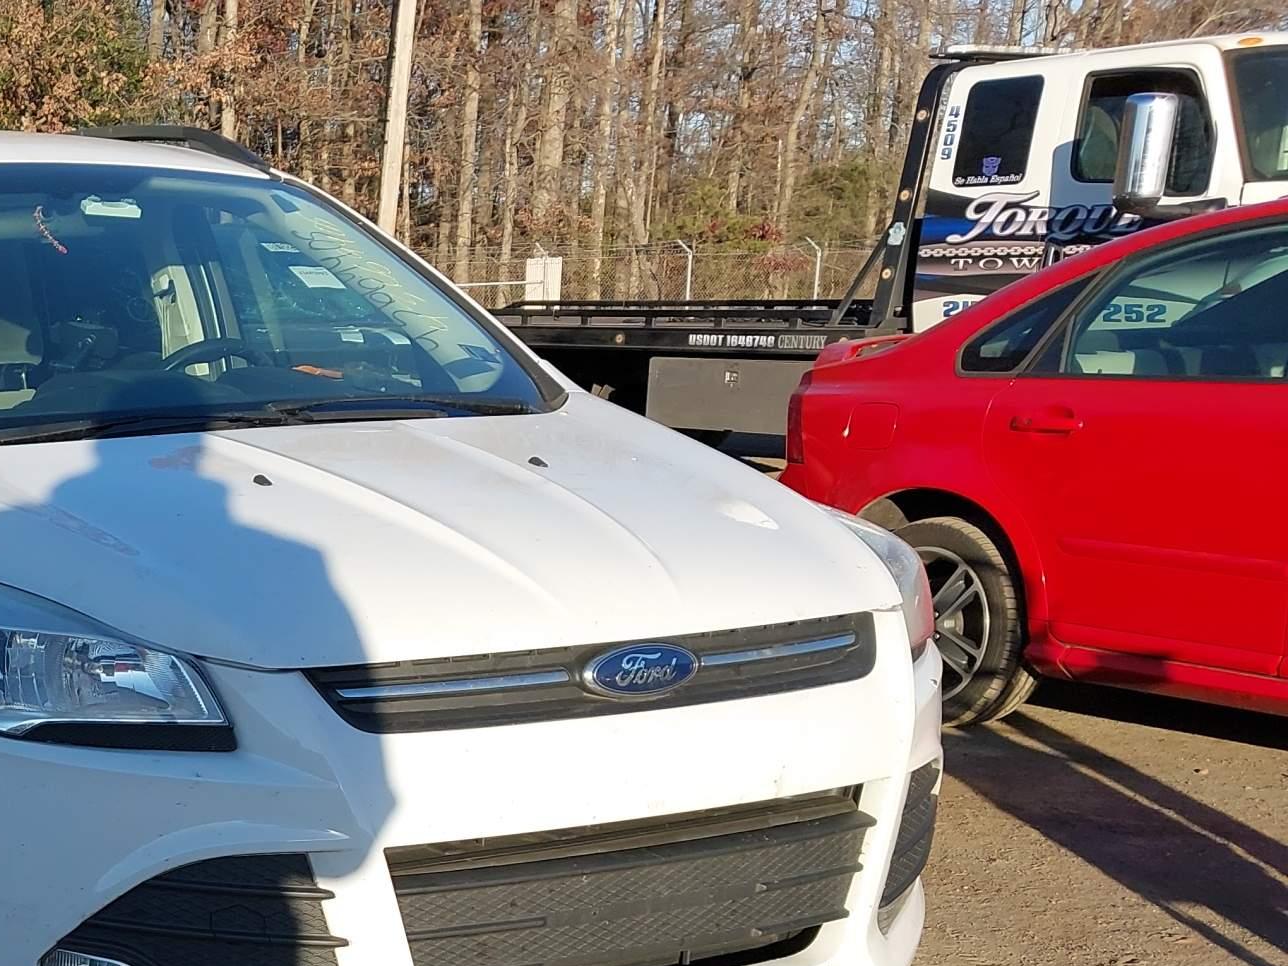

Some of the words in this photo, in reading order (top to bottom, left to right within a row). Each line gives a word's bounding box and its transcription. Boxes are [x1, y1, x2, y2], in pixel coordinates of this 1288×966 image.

[940, 105, 961, 160] 4509
[954, 176, 965, 185] Se
[1102, 303, 1167, 323] 252
[688, 333, 724, 346] USDOT
[777, 335, 827, 350] CENTURY
[615, 652, 678, 687] Ford
